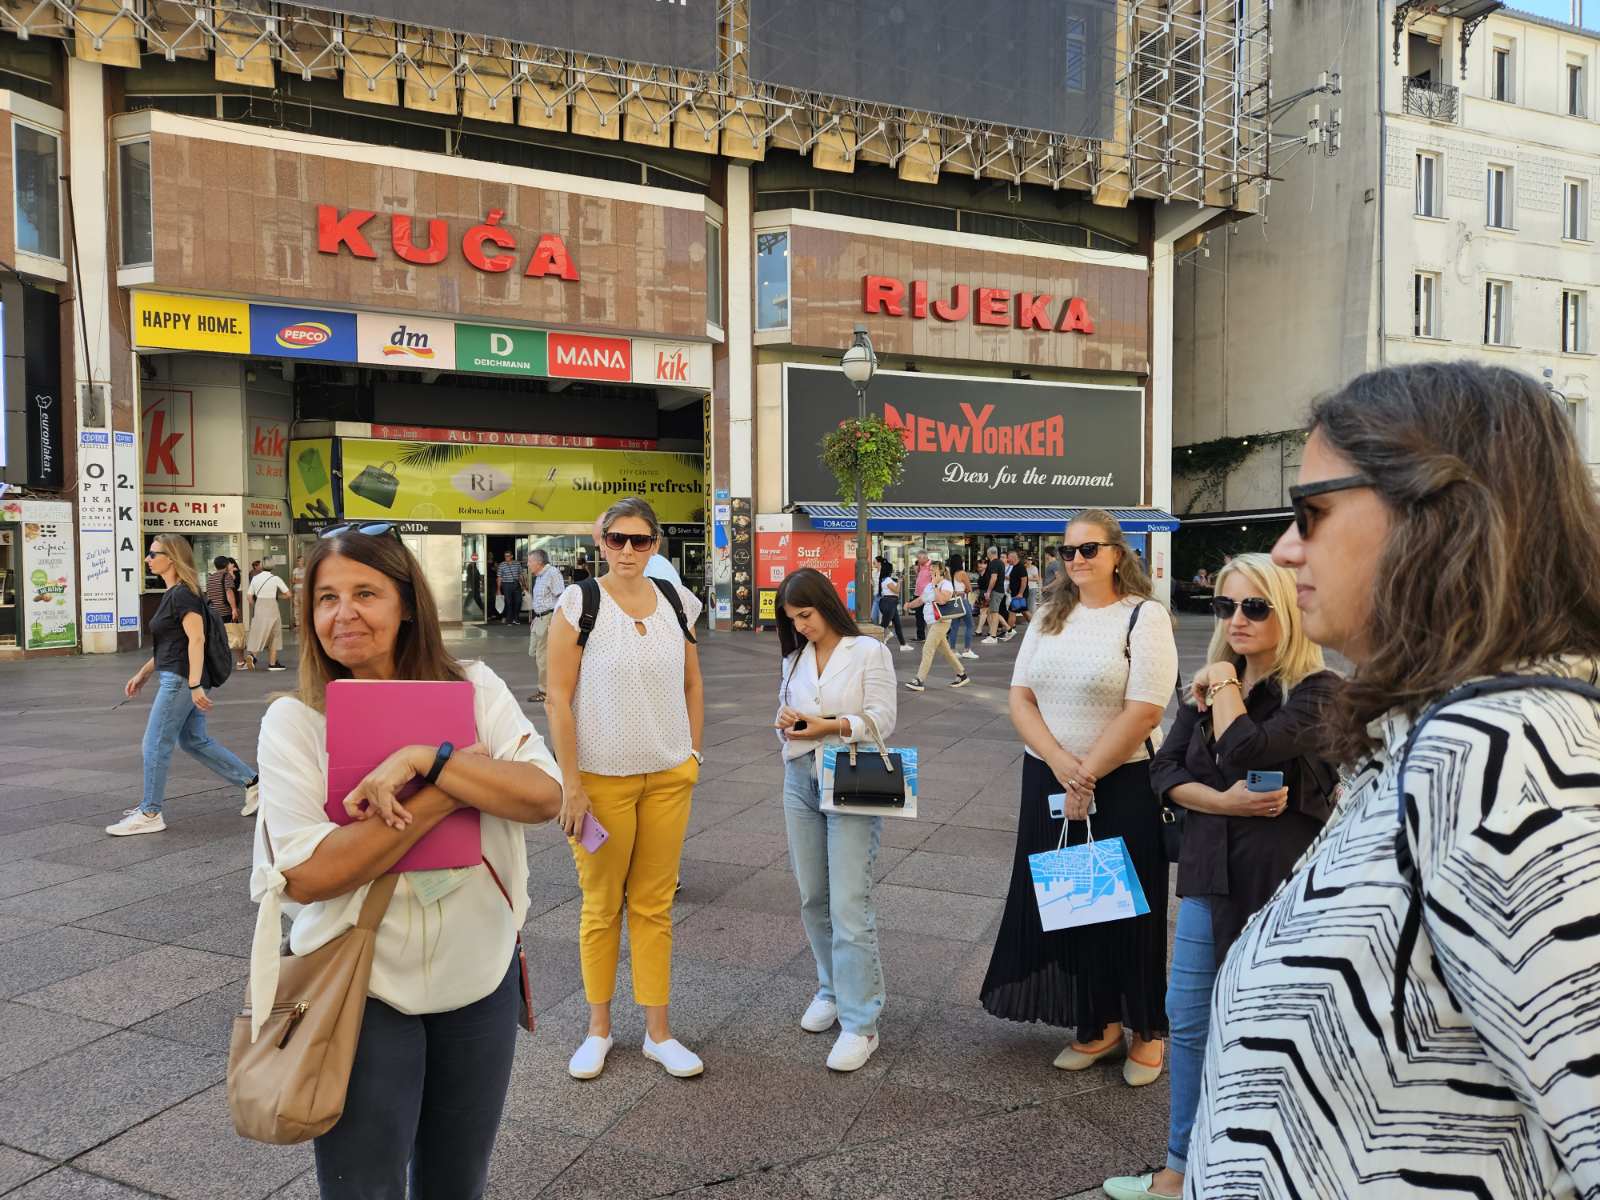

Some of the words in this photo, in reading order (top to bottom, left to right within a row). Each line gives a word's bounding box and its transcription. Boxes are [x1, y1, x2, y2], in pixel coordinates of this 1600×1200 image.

[317, 205, 580, 281] KUĆA
[864, 275, 1095, 334] RIJEKA
[143, 310, 191, 330] HAPPY
[198, 315, 242, 335] HOME.
[284, 330, 324, 341] PEPCO
[390, 325, 429, 347] dm
[490, 333, 514, 356] D
[474, 358, 531, 369] DEICHMANN
[556, 345, 626, 369] MANA
[656, 349, 688, 381] kik
[41, 413, 52, 473] europlakat
[448, 430, 541, 445] AUTOMAT
[549, 434, 593, 447] CLUB
[471, 473, 494, 492] Ri
[572, 478, 647, 495] Shopping
[650, 479, 702, 494] refresh
[942, 462, 989, 484] Dress
[989, 465, 1017, 490] for
[1023, 467, 1047, 485] the
[1051, 472, 1114, 487] moment.
[173, 519, 219, 527] EXCHANGE
[823, 520, 857, 528] TOBACCO
[797, 546, 821, 557] Surf
